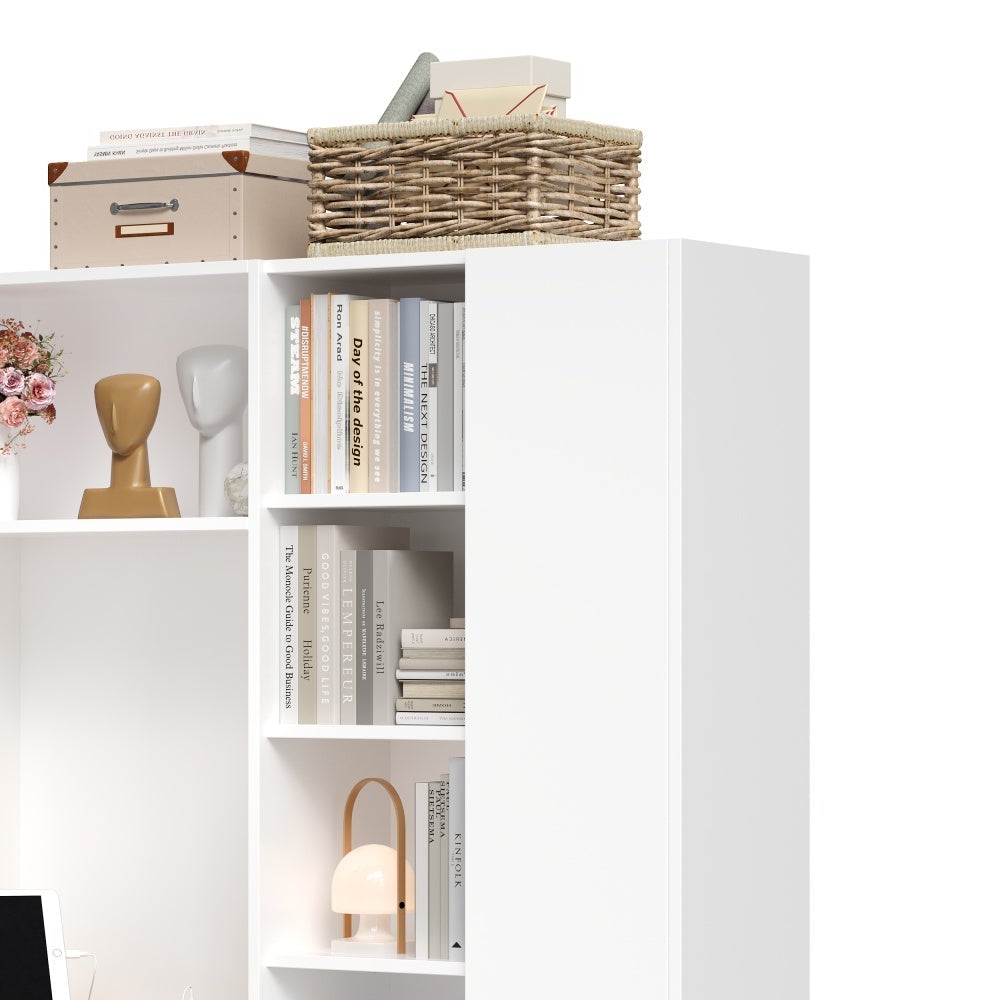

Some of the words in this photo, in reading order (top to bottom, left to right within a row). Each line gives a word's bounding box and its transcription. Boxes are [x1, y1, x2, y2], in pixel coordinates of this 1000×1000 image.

[352, 337, 363, 366] Day
[354, 370, 363, 386] of
[353, 390, 363, 413] the
[403, 362, 414, 433] MINIMALISM
[352, 418, 363, 466] design
[376, 600, 384, 619] Lee
[286, 634, 293, 642] to
[343, 589, 353, 704] LEMPEREUR
[376, 623, 384, 674] Radziwill
[300, 640, 312, 680] Holiday
